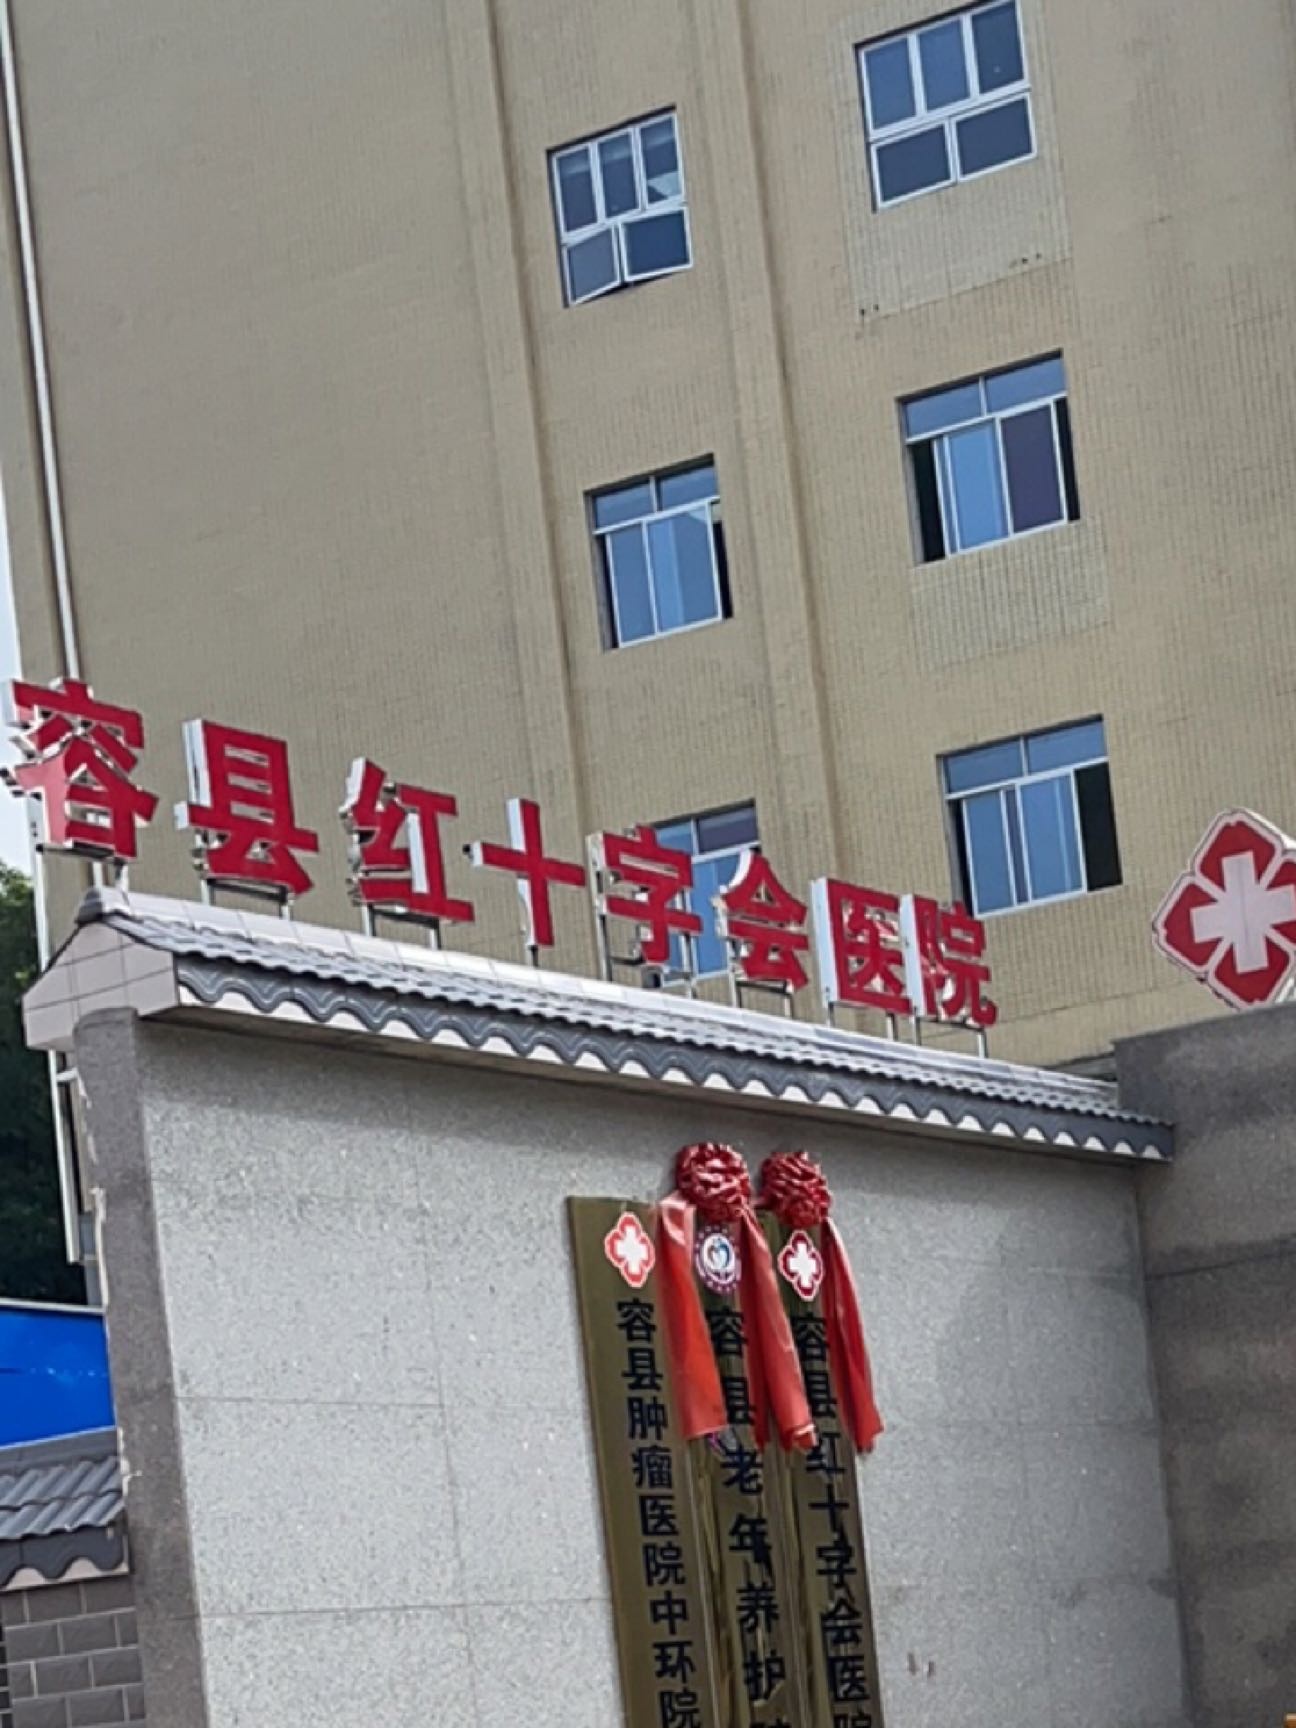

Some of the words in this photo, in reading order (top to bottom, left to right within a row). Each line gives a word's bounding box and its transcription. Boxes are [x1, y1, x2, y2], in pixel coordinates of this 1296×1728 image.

[6, 678, 999, 1028] 容县红十字会医院
